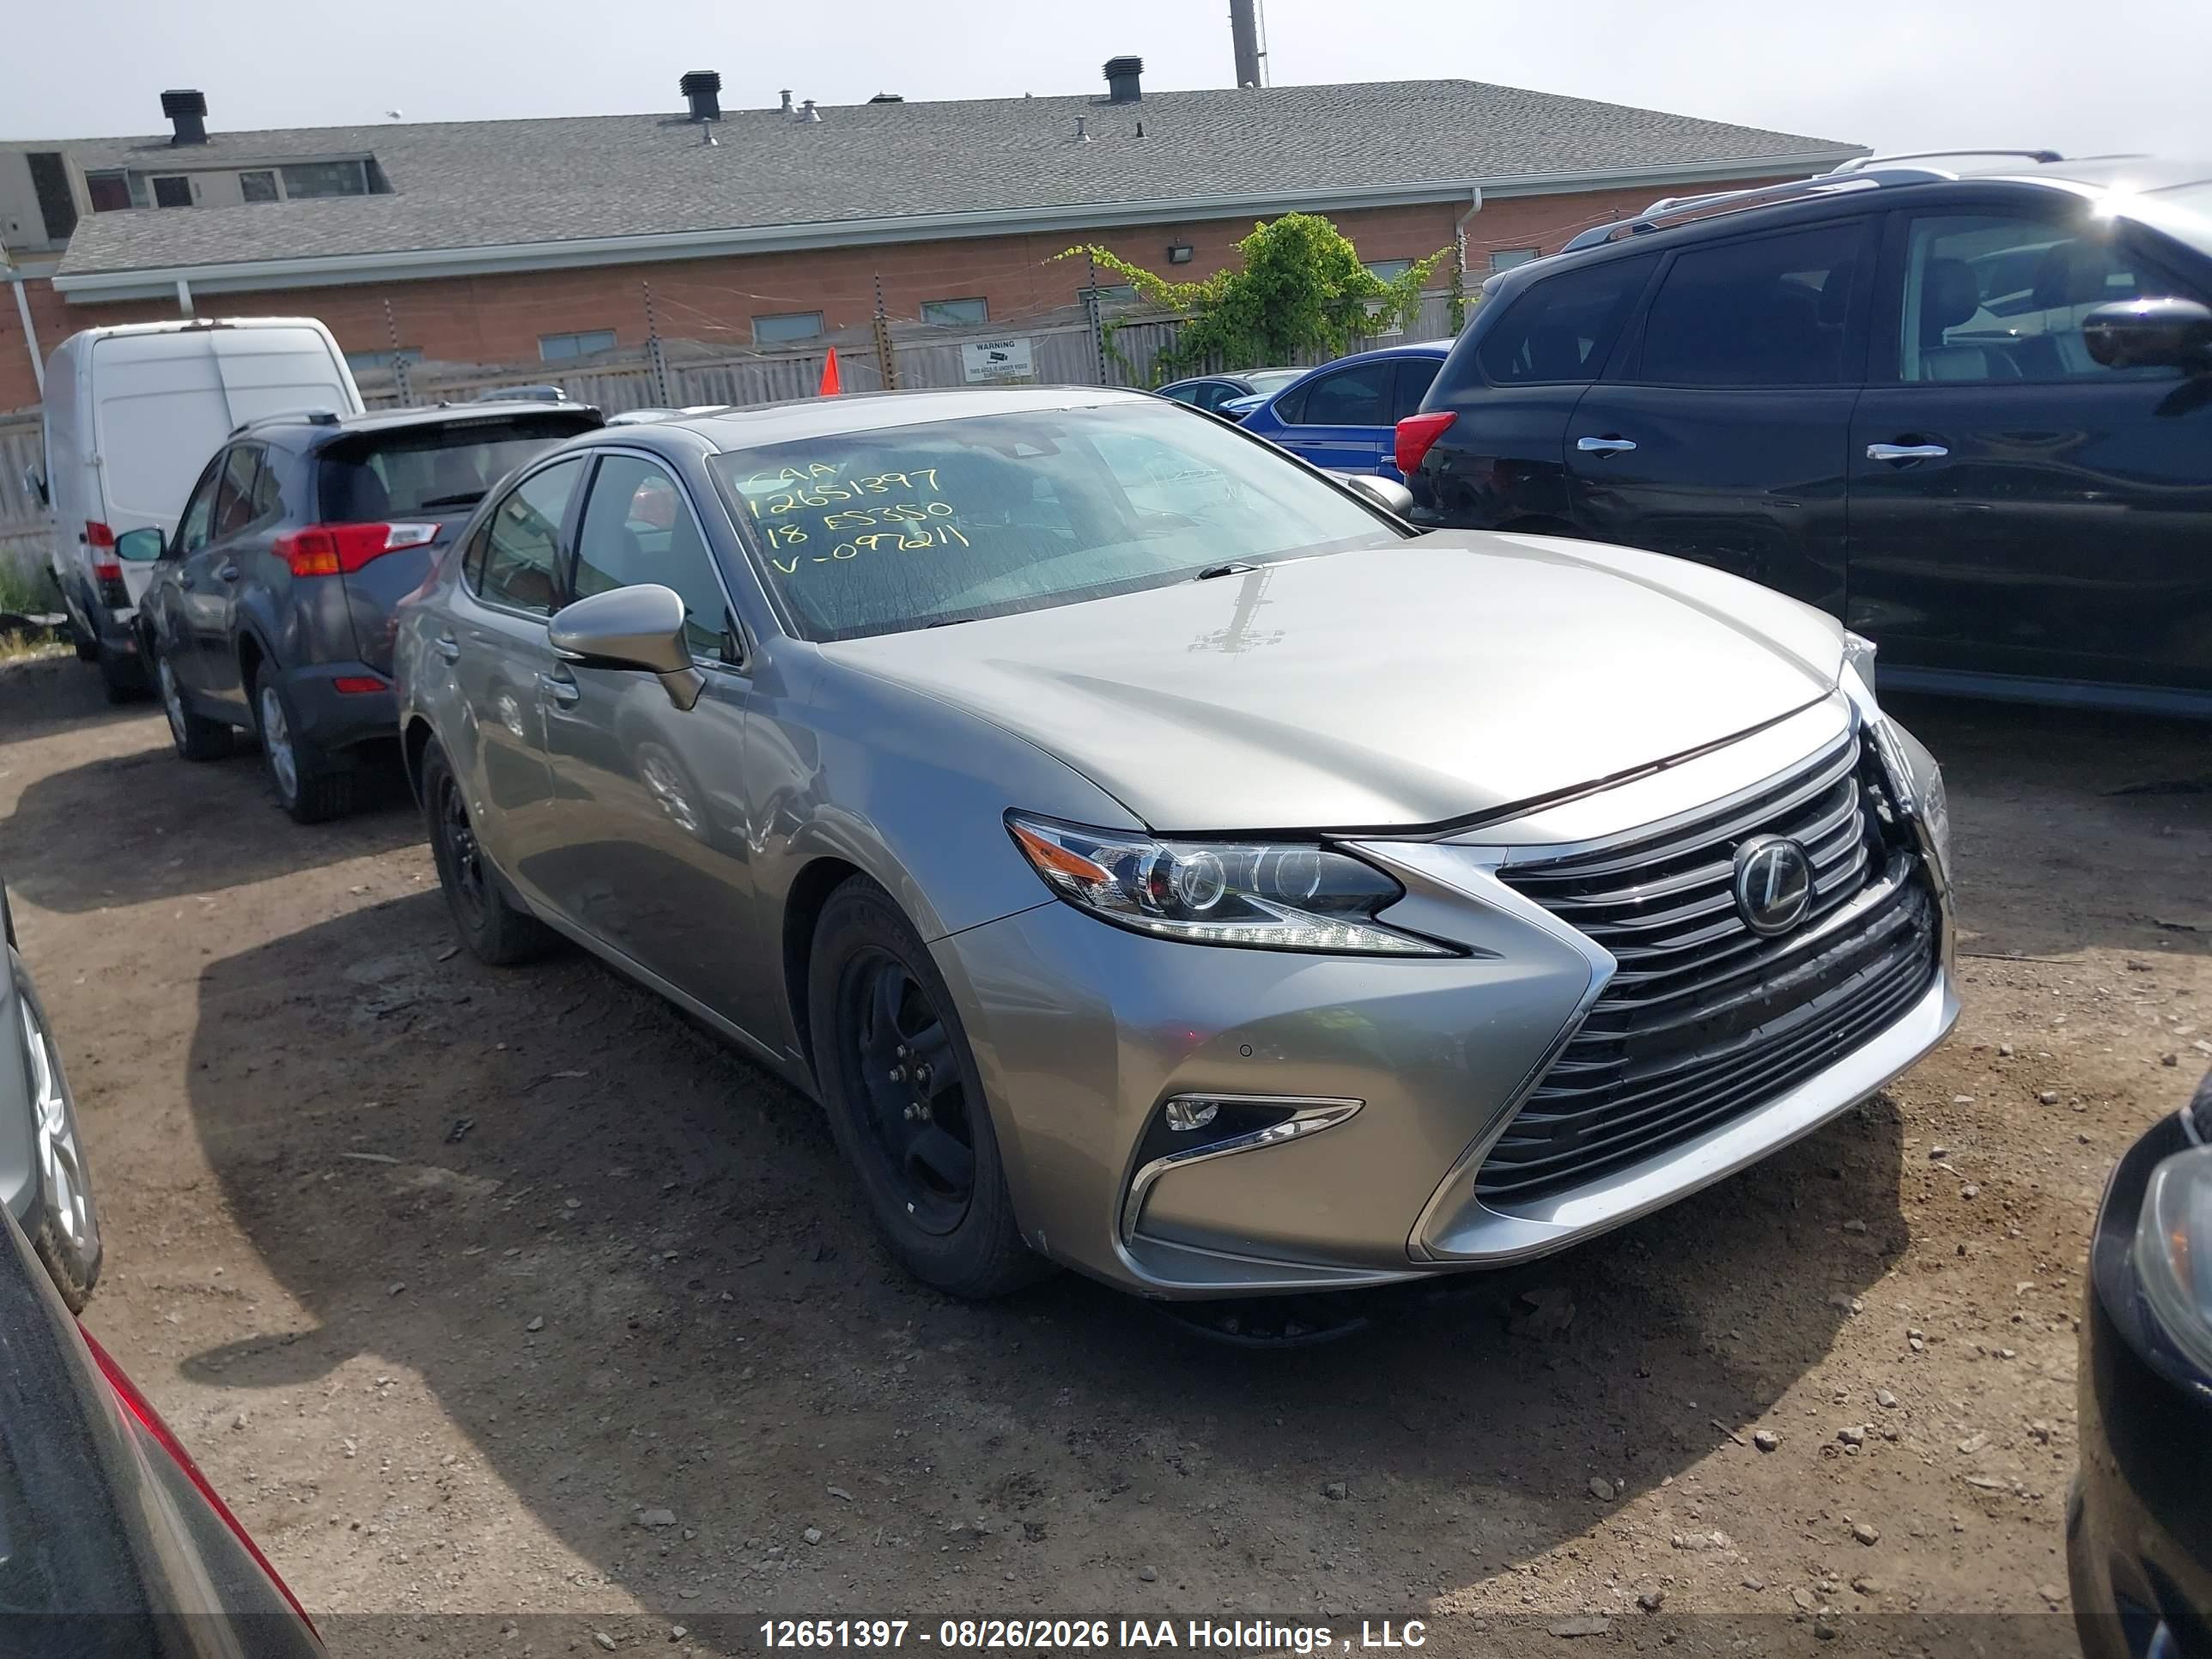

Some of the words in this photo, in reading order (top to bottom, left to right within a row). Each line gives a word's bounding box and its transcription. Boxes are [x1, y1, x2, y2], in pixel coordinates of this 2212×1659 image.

[976, 341, 1015, 350] WARNING
[750, 469, 939, 520] 12651397
[767, 524, 808, 549] 18
[823, 502, 953, 530] ES350
